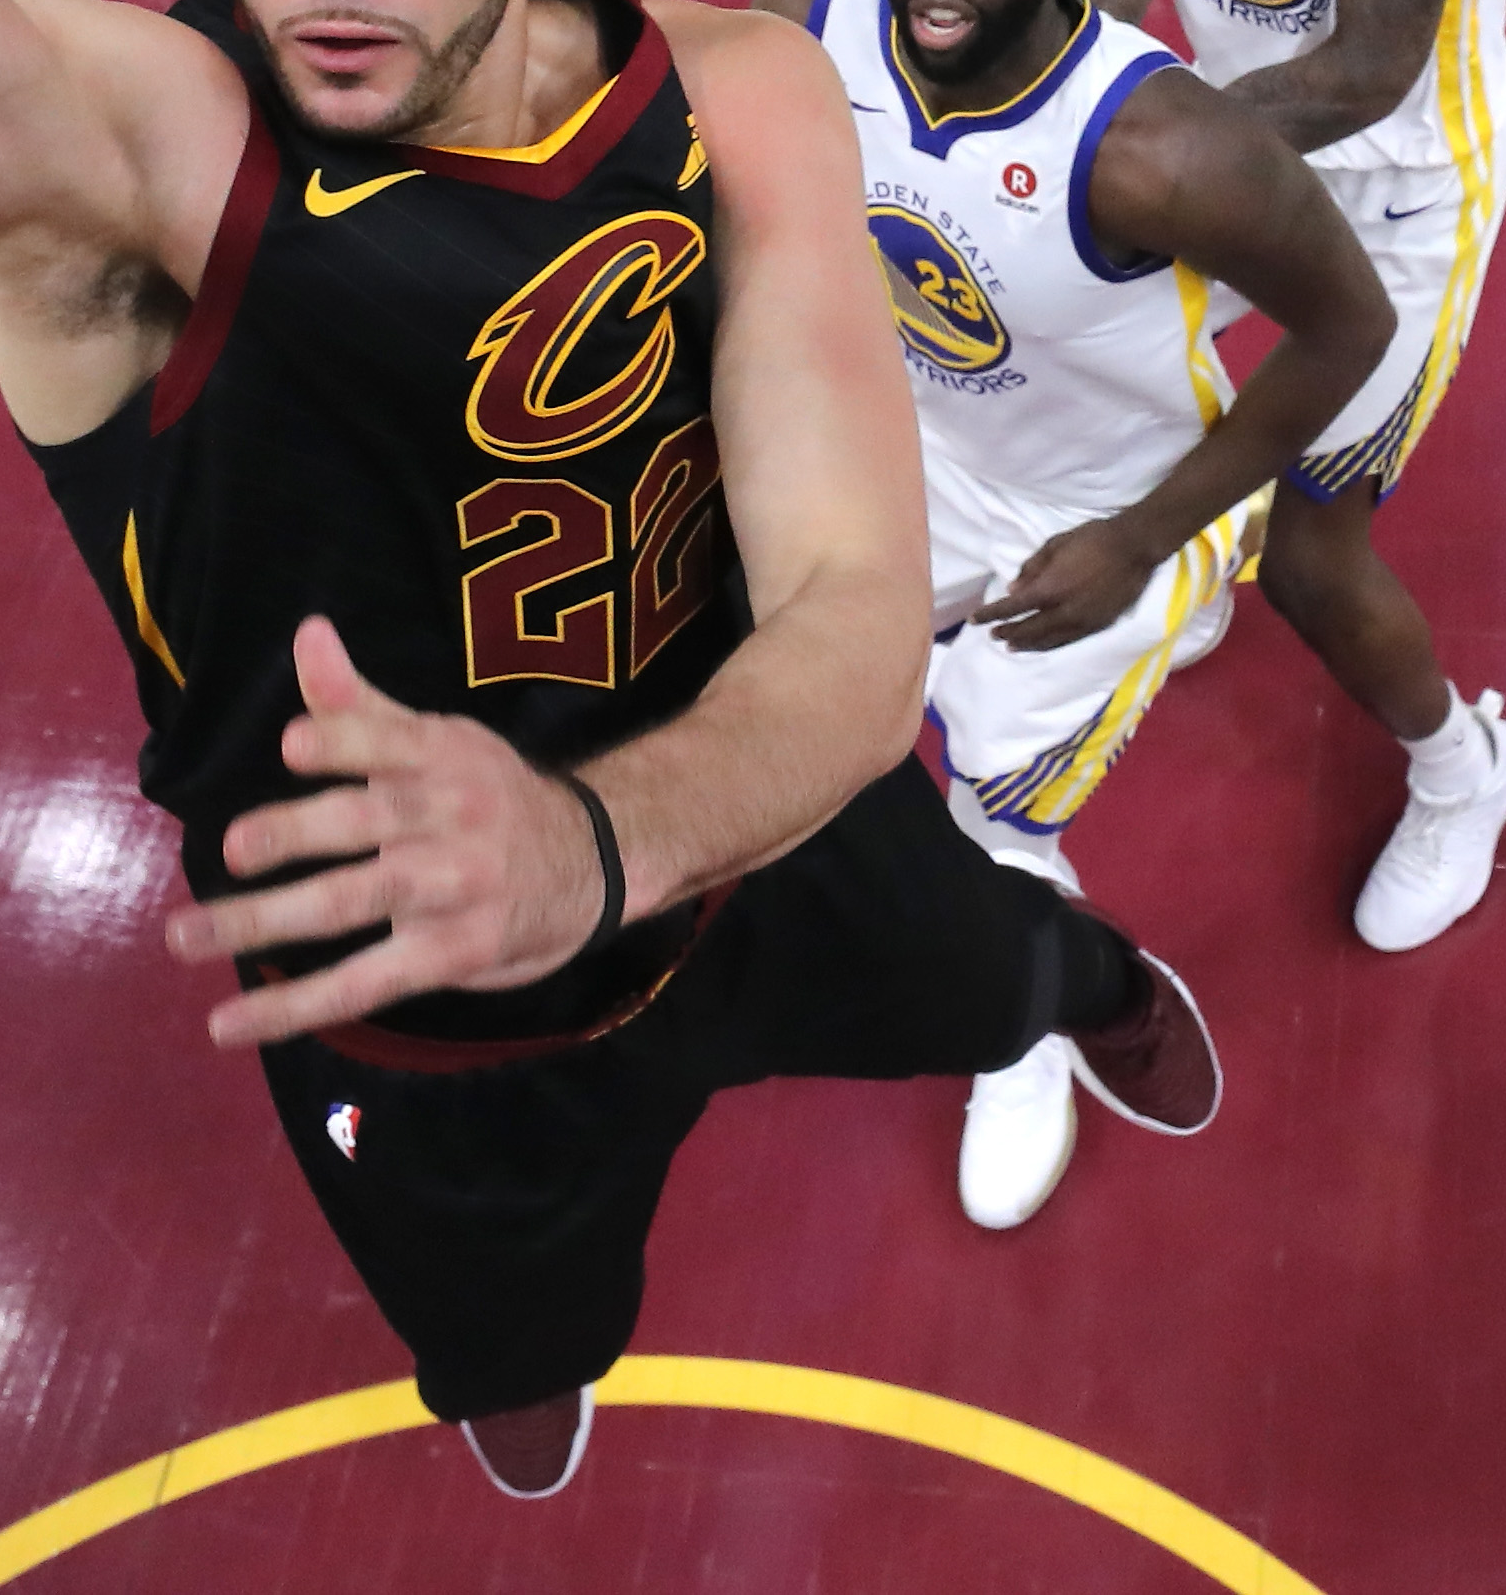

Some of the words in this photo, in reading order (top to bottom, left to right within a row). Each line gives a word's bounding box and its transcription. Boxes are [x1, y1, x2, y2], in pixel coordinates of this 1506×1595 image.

[1007, 166, 1033, 196] R
[914, 259, 984, 322] 23
[938, 210, 1008, 296] STATE
[465, 210, 706, 463] C
[456, 416, 722, 690] 22
